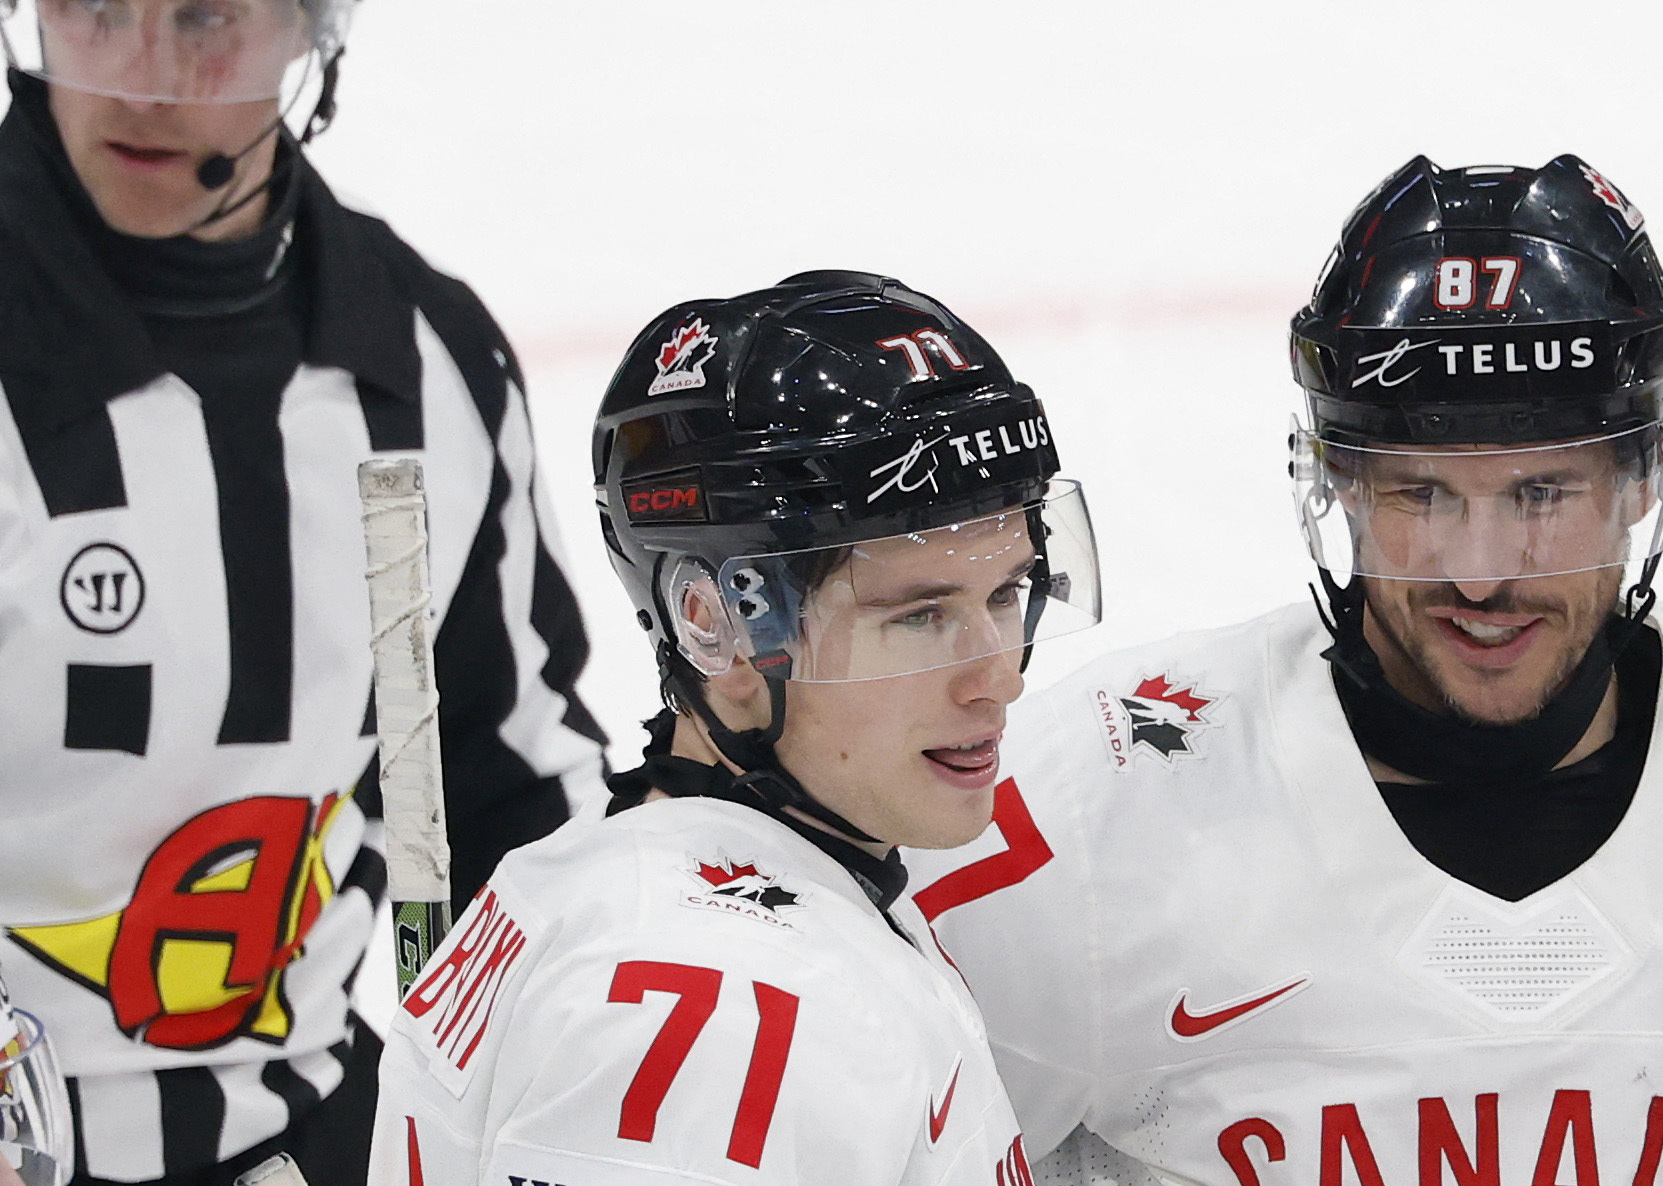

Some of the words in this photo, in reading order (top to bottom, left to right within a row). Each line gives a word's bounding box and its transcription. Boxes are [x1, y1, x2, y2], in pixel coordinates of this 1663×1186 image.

[1434, 256, 1522, 310] 87
[875, 327, 969, 378] 71
[1439, 337, 1594, 375] TELUS
[651, 377, 702, 393] CANADA
[948, 416, 1049, 467] TELUS
[630, 488, 697, 512] CCM
[1096, 689, 1127, 768] CANADA
[686, 894, 795, 929] CANADA
[607, 959, 800, 1170] 71
